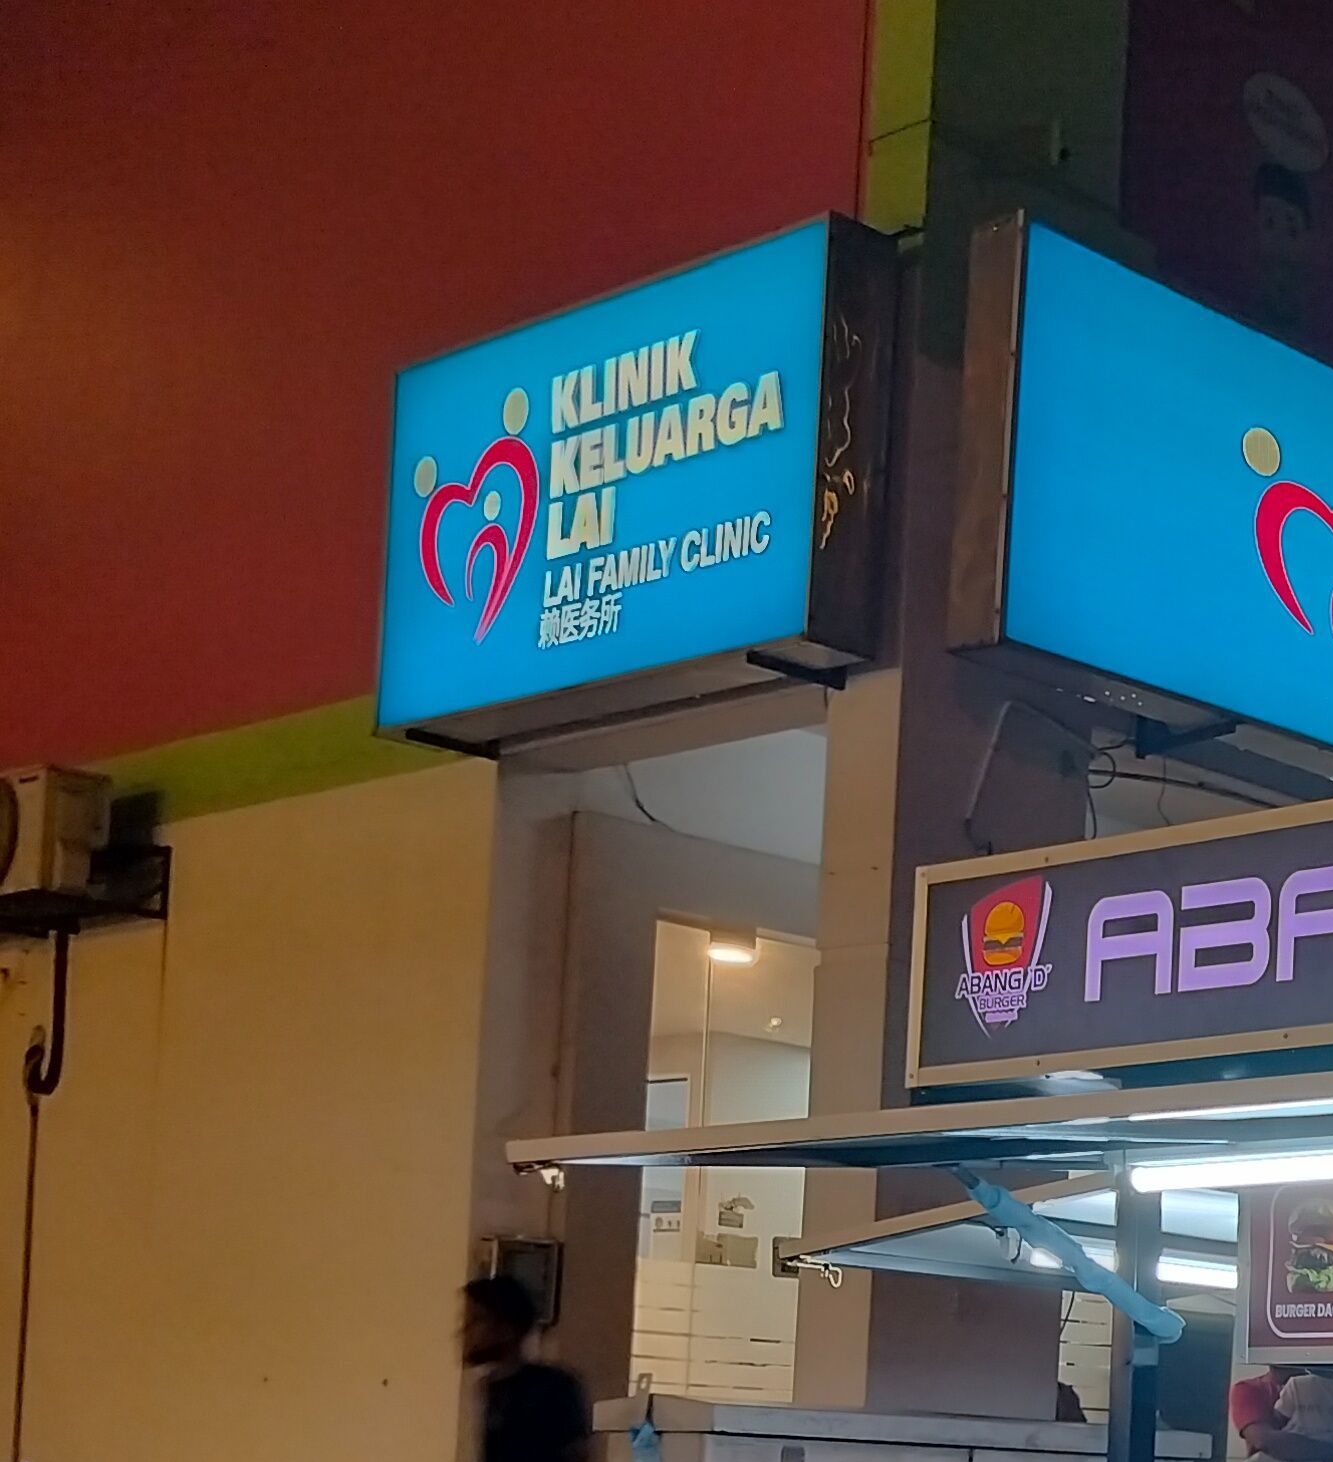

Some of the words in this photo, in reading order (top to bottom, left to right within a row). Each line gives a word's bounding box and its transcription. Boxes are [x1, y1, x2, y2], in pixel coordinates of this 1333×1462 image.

[551, 329, 699, 433] KLINIK
[550, 371, 783, 498] KELUARGA
[546, 488, 616, 560] LAI
[543, 569, 581, 608] LAI
[587, 538, 677, 595] FAMILY
[681, 511, 771, 573] CLINIC
[538, 593, 622, 649] 赖医务所
[955, 968, 1023, 999] ABANG
[979, 994, 1026, 1011] BURGER
[1276, 1304, 1315, 1317] BURGER
